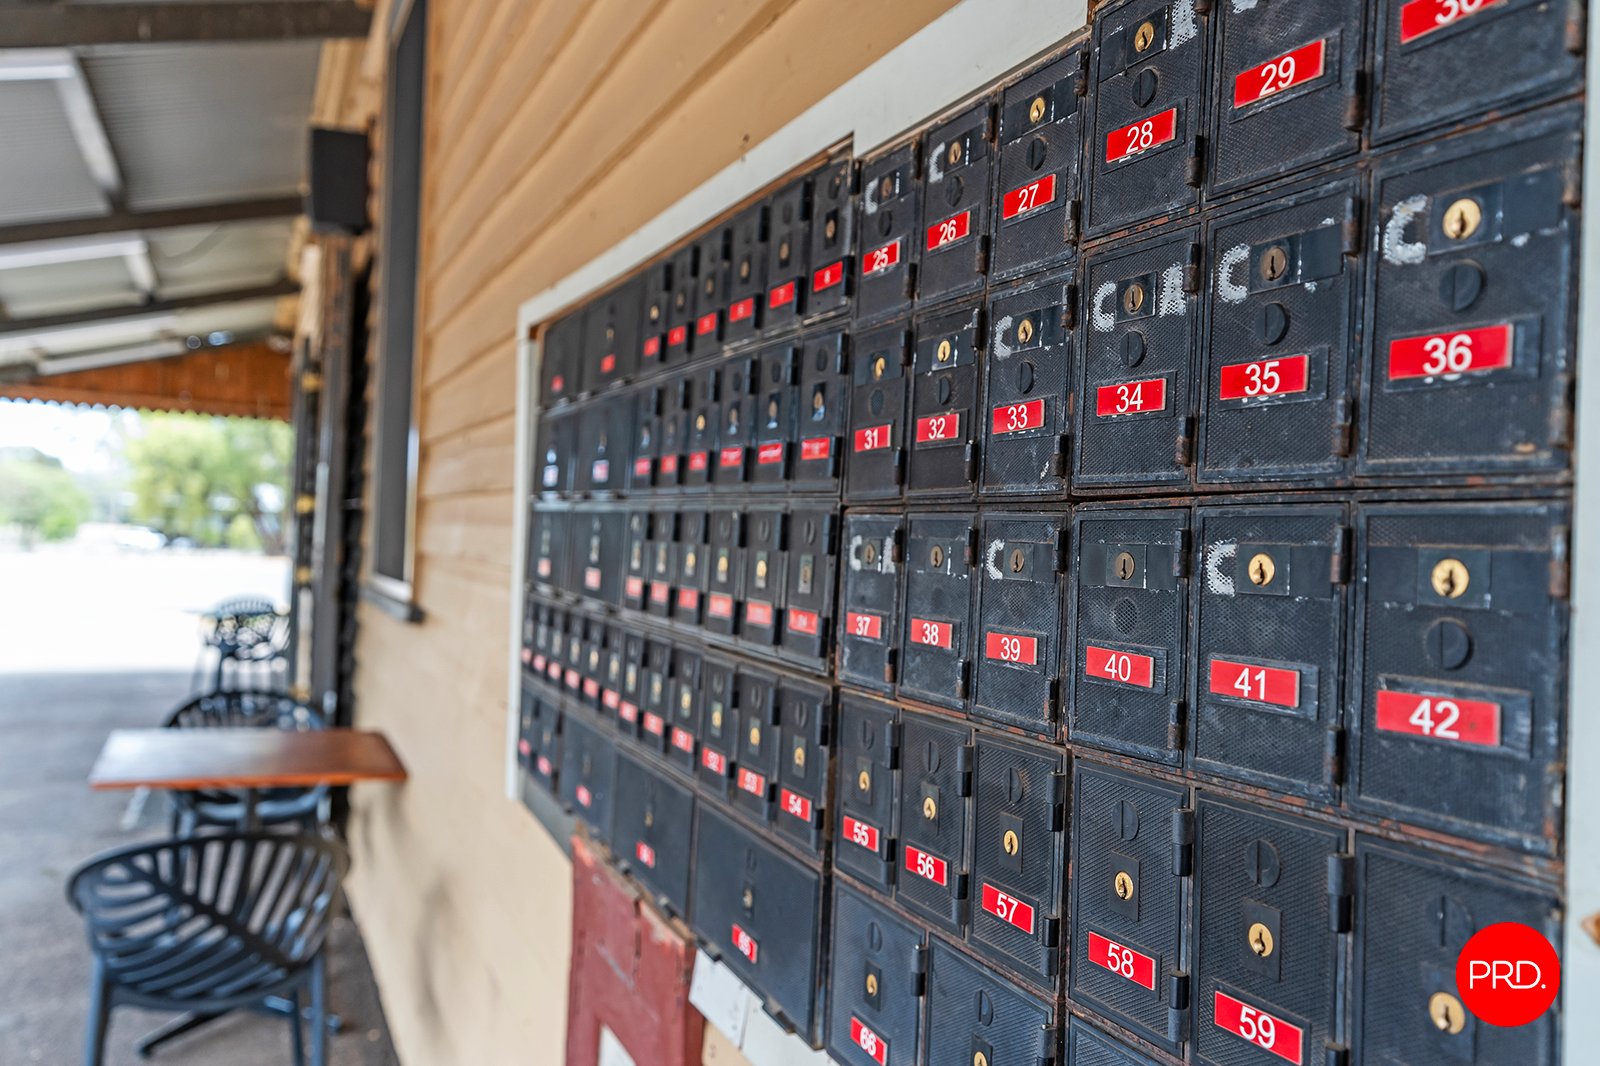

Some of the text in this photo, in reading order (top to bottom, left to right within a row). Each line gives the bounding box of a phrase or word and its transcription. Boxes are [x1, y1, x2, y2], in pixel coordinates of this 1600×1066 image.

[1259, 56, 1296, 97] 29
[1126, 121, 1153, 154] 28
[1017, 183, 1039, 213] 27
[938, 219, 957, 245] 26
[872, 247, 889, 271] 25
[1422, 333, 1473, 375] 36
[1243, 361, 1281, 395] 35
[1115, 383, 1143, 413] 34
[928, 417, 946, 440] 32
[1007, 404, 1028, 431] 33
[864, 429, 879, 450] 31
[855, 615, 871, 636] 37
[922, 622, 939, 646] 38
[1000, 636, 1021, 662] 39
[1104, 653, 1132, 682] 40
[1234, 667, 1267, 700] 41
[1408, 698, 1460, 739] 42
[788, 794, 803, 815] 54
[852, 821, 869, 847] 55
[916, 853, 935, 880] 56
[996, 893, 1019, 923] 57
[1107, 943, 1135, 979] 58
[859, 1026, 877, 1056] 66
[1239, 1005, 1276, 1050] 59
